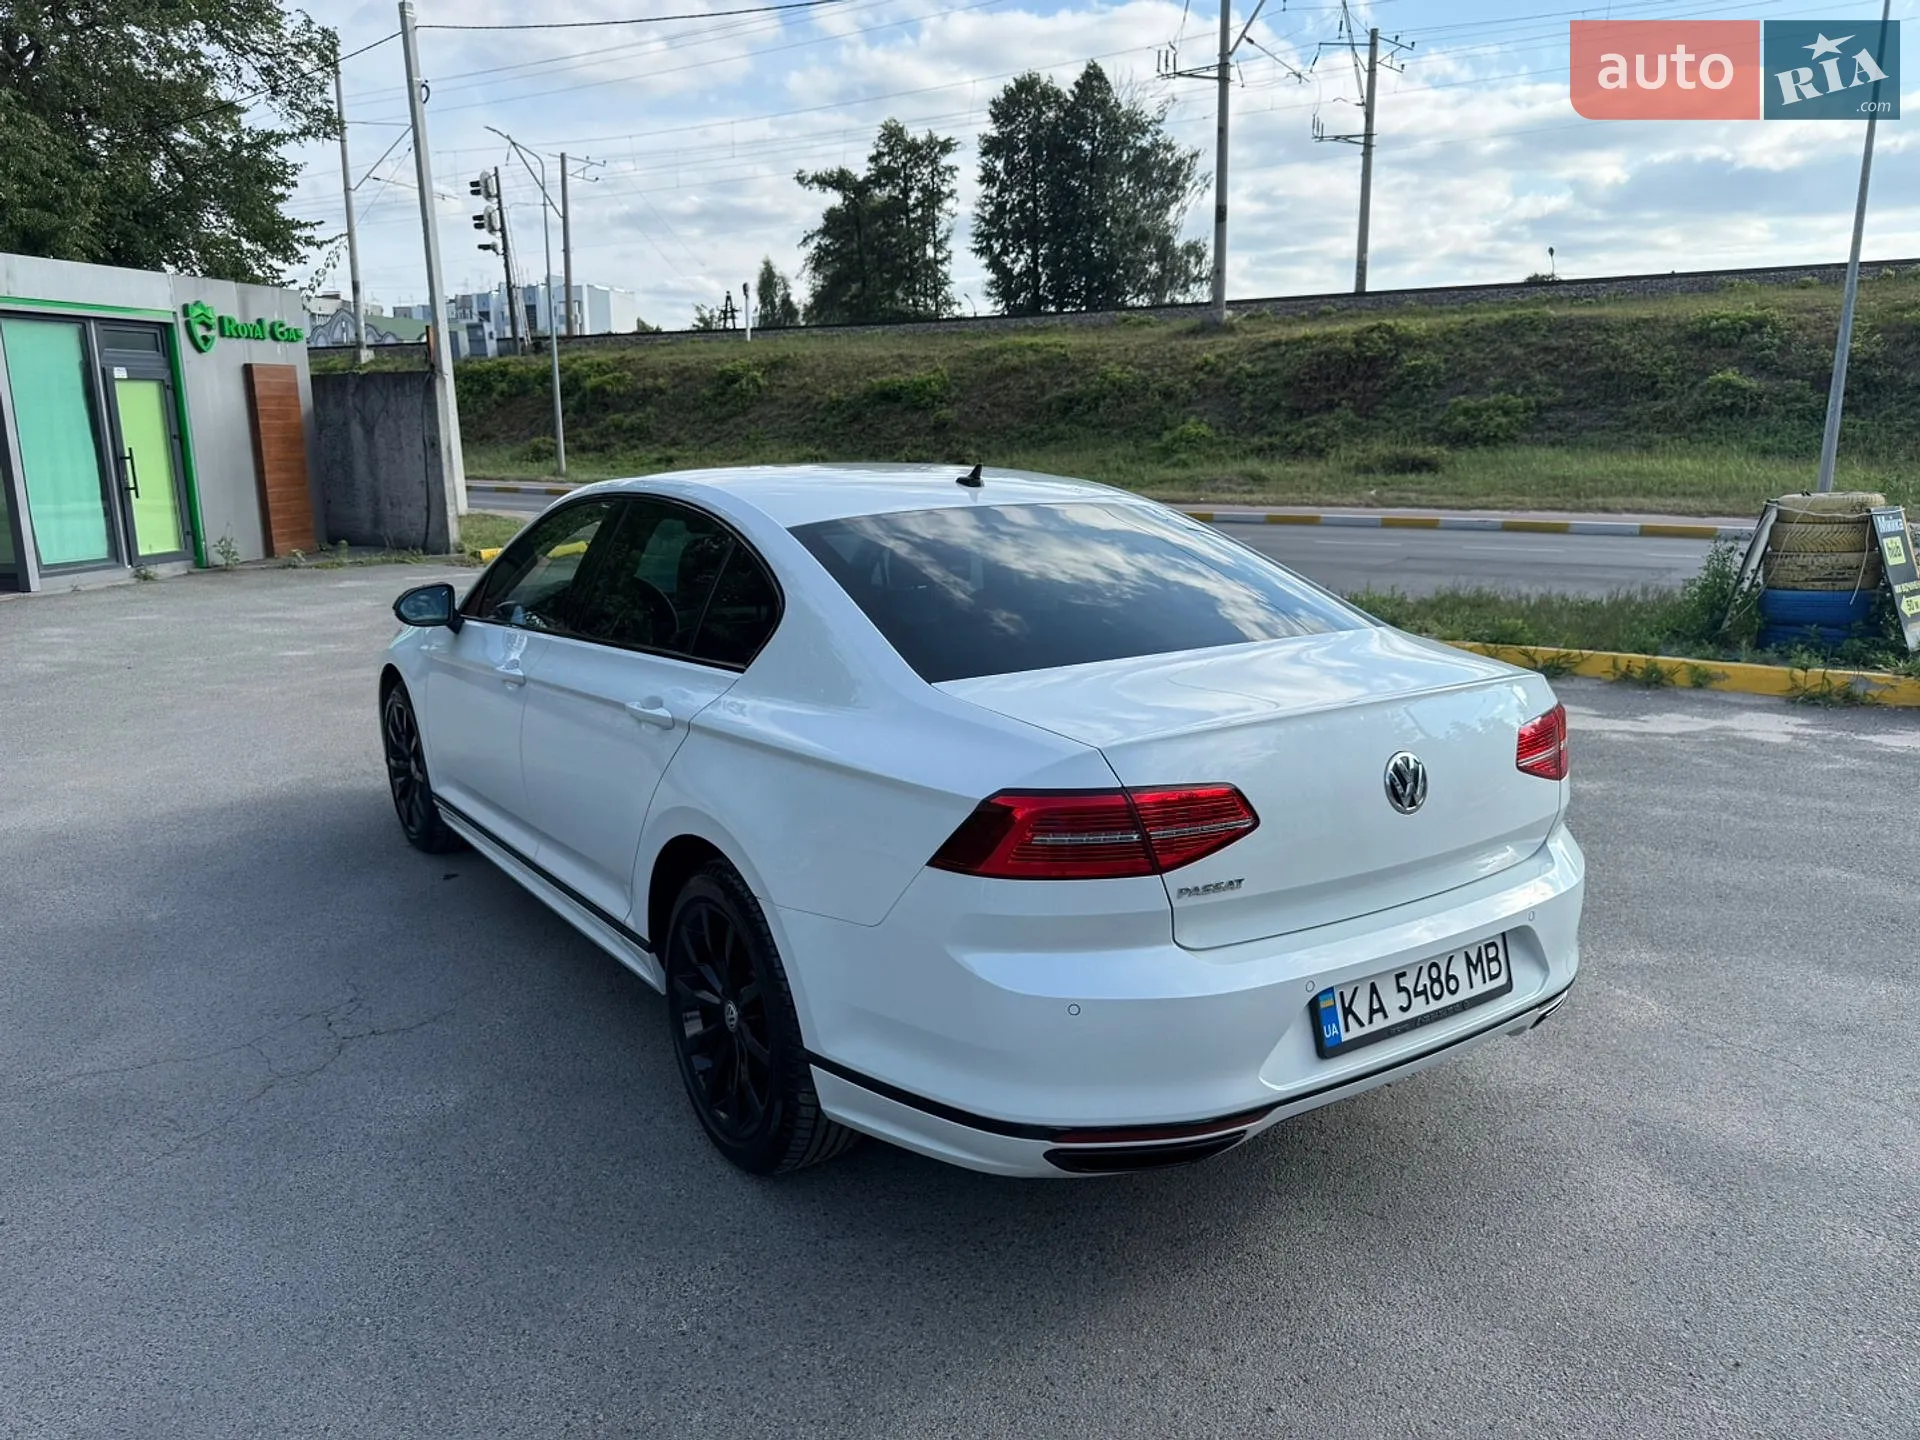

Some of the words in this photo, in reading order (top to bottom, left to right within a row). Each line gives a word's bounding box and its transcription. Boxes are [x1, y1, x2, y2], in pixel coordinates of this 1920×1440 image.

[1176, 878, 1245, 900] PASSAT
[1339, 981, 1389, 1033] KA
[1395, 955, 1460, 1013] 5486
[1464, 941, 1503, 989] MB
[1323, 1023, 1339, 1039] UA
